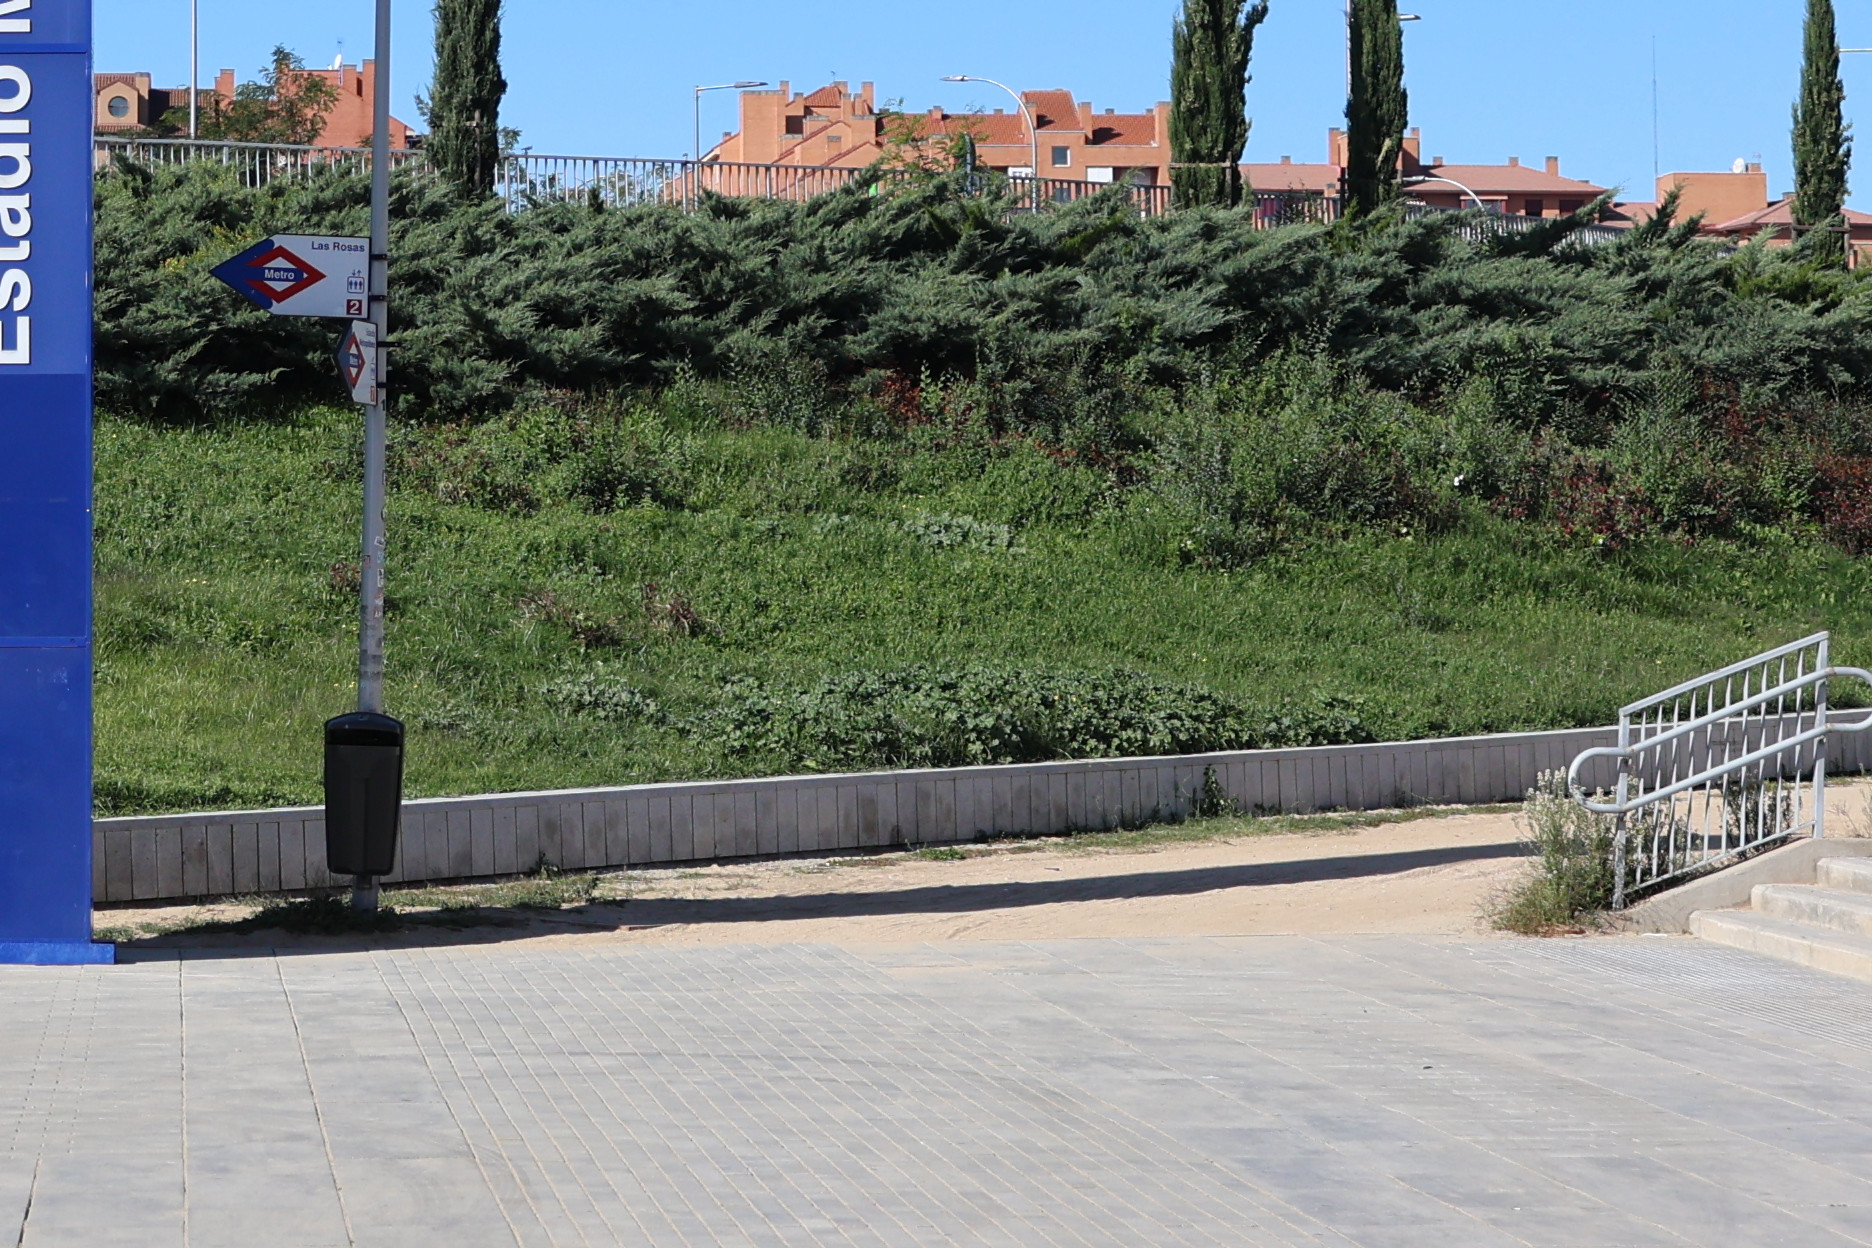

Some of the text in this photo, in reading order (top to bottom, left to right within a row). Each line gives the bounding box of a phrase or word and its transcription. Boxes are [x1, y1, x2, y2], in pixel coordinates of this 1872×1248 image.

[311, 241, 365, 252] Las Rosas
[264, 269, 295, 280] Metro
[349, 300, 360, 314] 2
